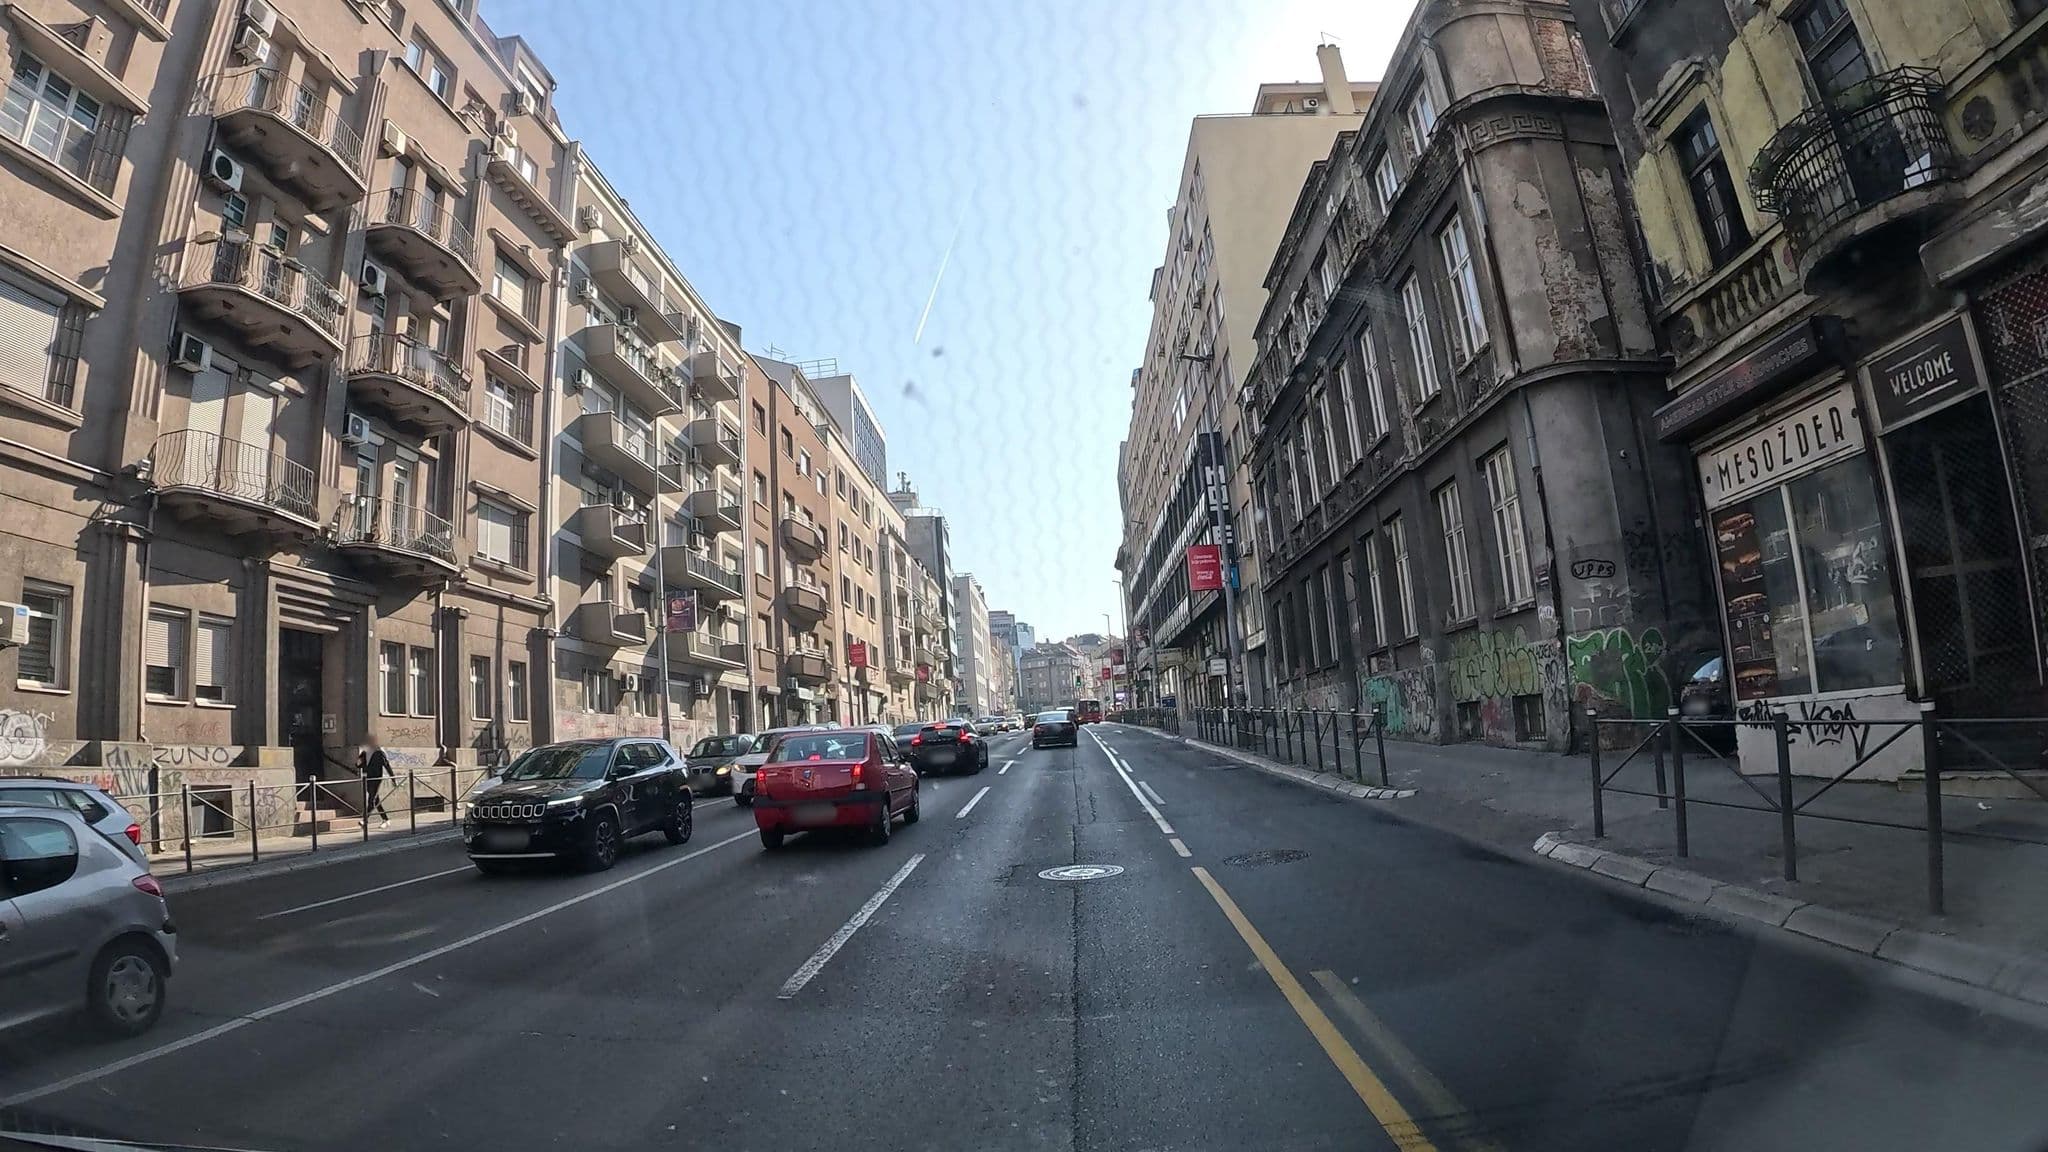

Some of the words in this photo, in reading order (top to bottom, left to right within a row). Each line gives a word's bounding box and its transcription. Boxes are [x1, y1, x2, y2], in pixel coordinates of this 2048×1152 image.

[1889, 351, 1954, 397] WELCOME
[1717, 406, 1845, 492] MESOŽDER
[152, 747, 229, 765] ZUNO
